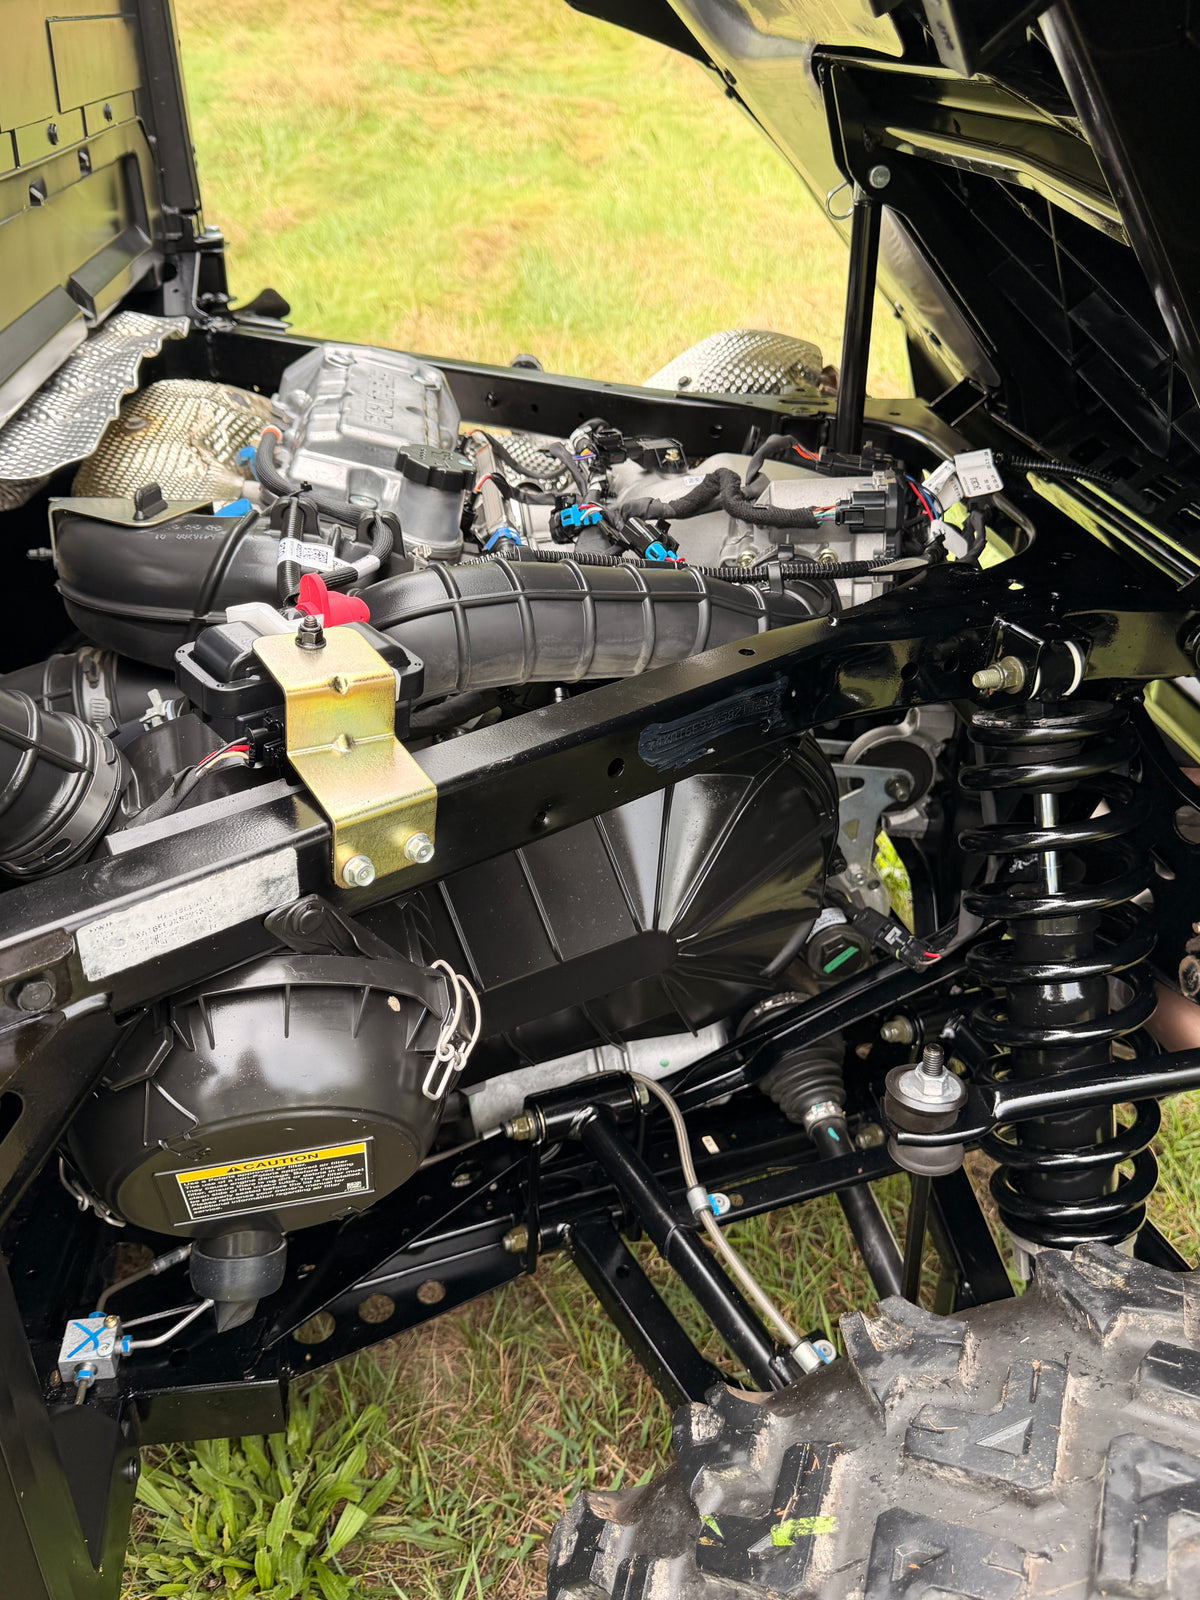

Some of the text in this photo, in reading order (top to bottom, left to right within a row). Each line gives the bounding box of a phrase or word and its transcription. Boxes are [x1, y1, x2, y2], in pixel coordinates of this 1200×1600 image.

[243, 1152, 318, 1170] CAUTION
[320, 1162, 353, 1170] installing
[234, 1171, 278, 1181] non-Polaris
[280, 1164, 317, 1173] approved
[237, 1168, 274, 1177] approved
[192, 1201, 229, 1210] additional
[231, 1194, 274, 1203] information
[275, 1187, 311, 1196] regarding
[201, 1193, 233, 1201] properly
[218, 1193, 254, 1202] reference
